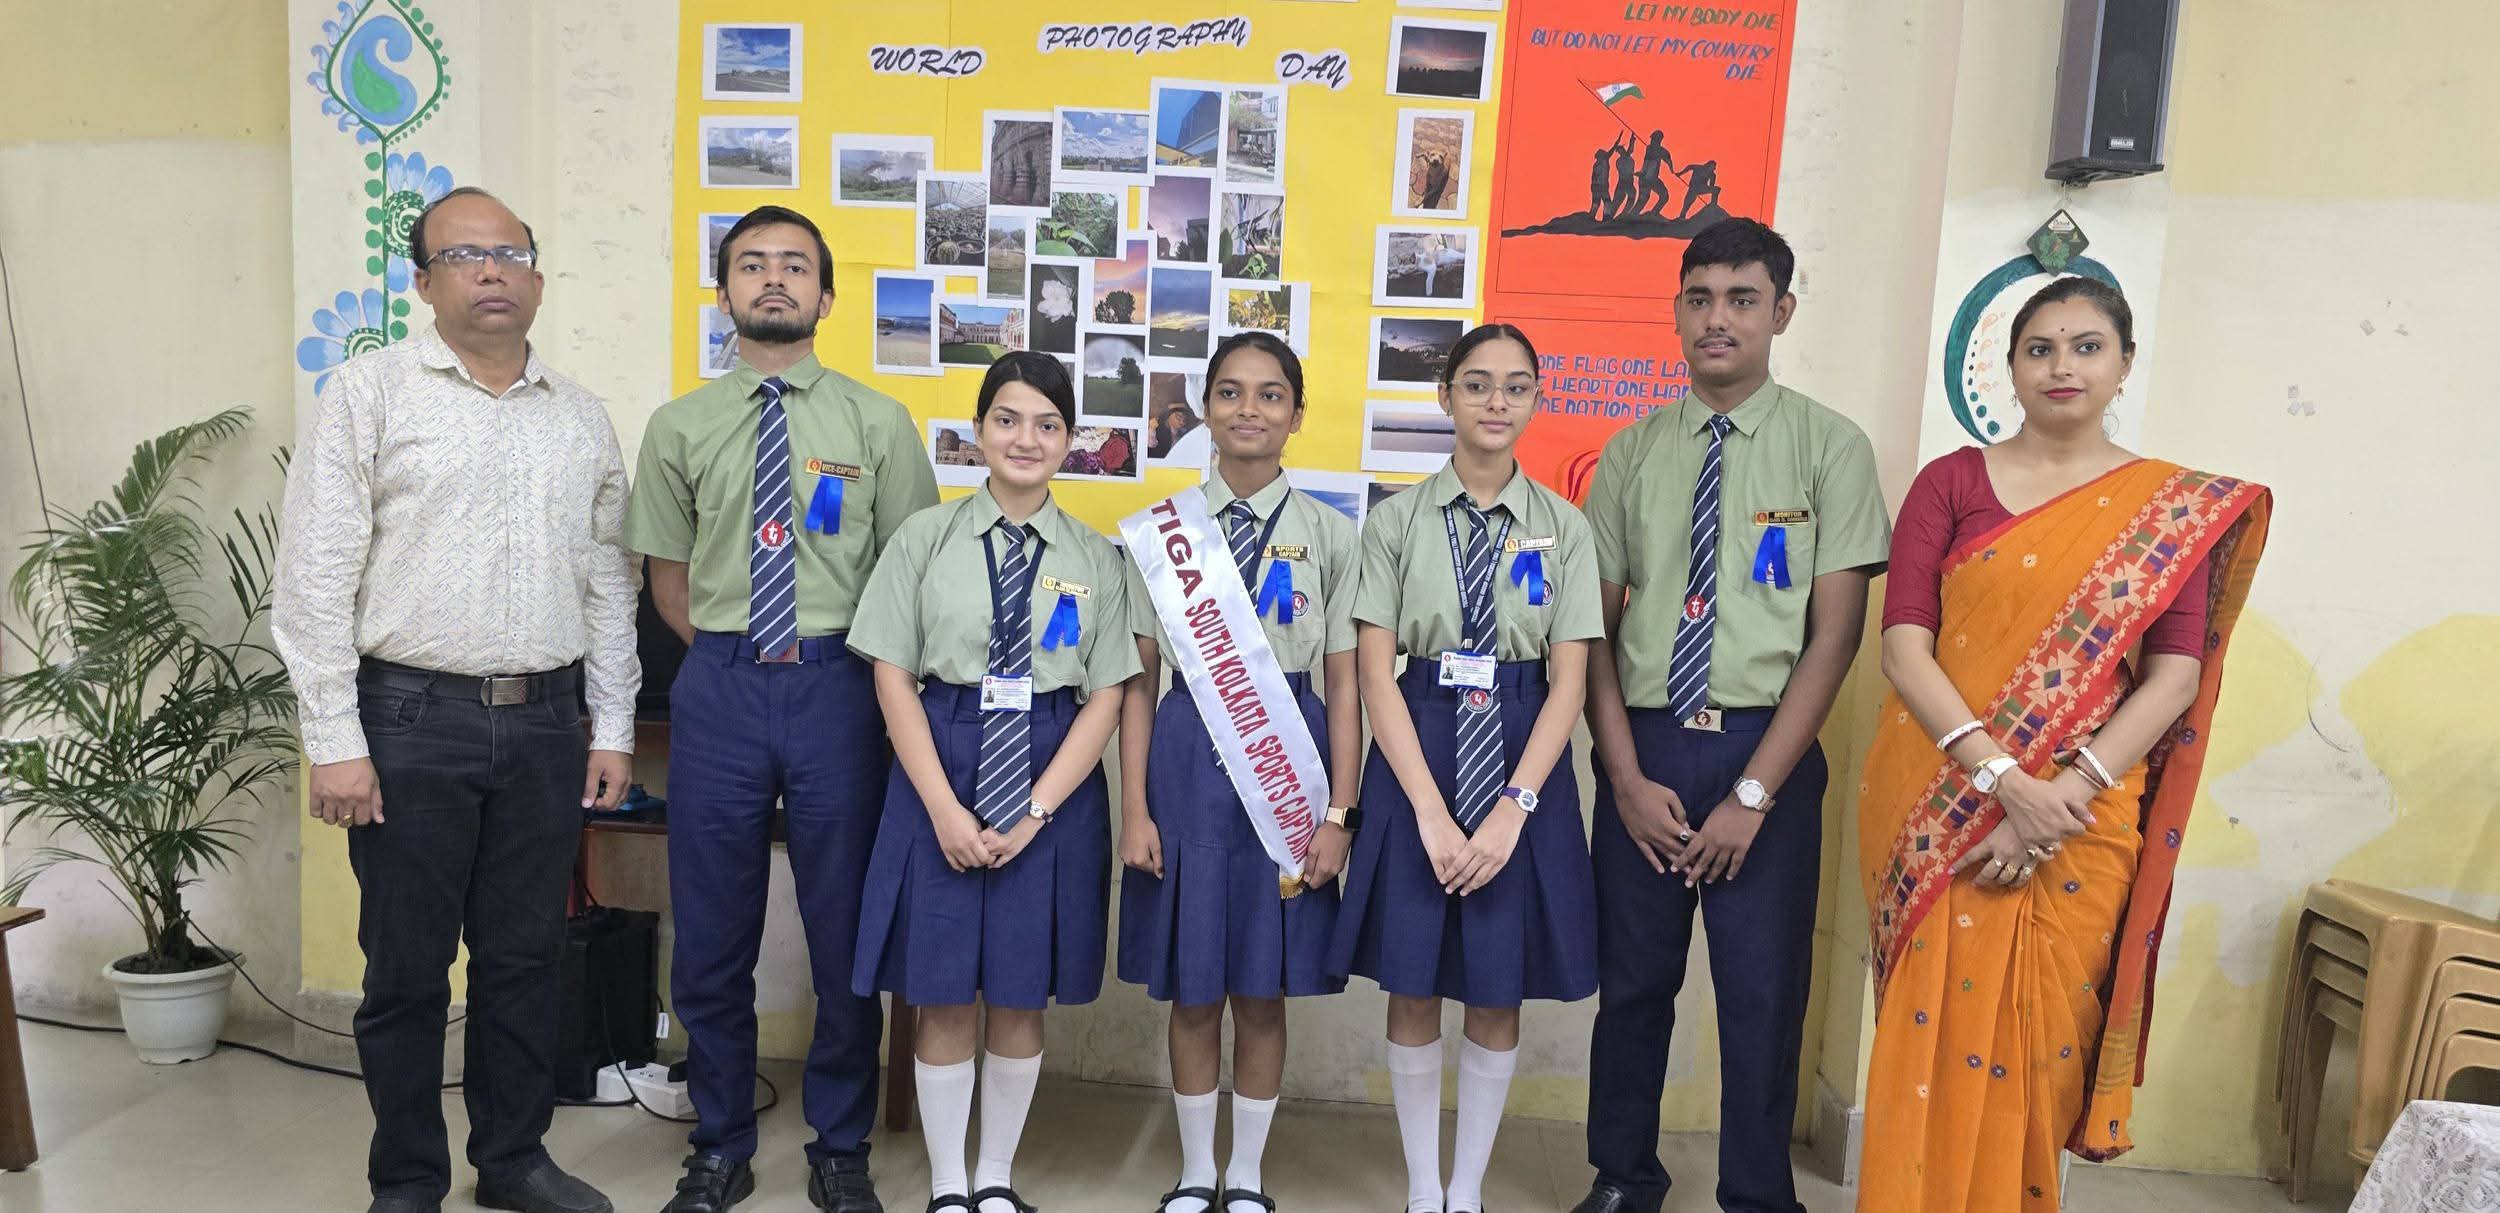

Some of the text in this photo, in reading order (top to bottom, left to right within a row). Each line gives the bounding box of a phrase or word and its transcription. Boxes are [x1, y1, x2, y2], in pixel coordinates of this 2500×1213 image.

[1624, 3, 1782, 30] LET MY BODY DIE
[871, 18, 1348, 88] WORLD PHOTOGRAPHY DAY
[1531, 28, 1774, 60] BUT DO NOT LET MY COUNTRY
[1726, 63, 1764, 80] DIE
[1538, 354, 1567, 371] ONE
[1621, 359, 1656, 377] ONE
[1614, 381, 1650, 398] ONE
[1538, 396, 1562, 413] NE
[1565, 398, 1632, 419] NATION
[1151, 498, 1316, 865] TIGA SOUTH KOLKATA SPORTS CAPTAIN
